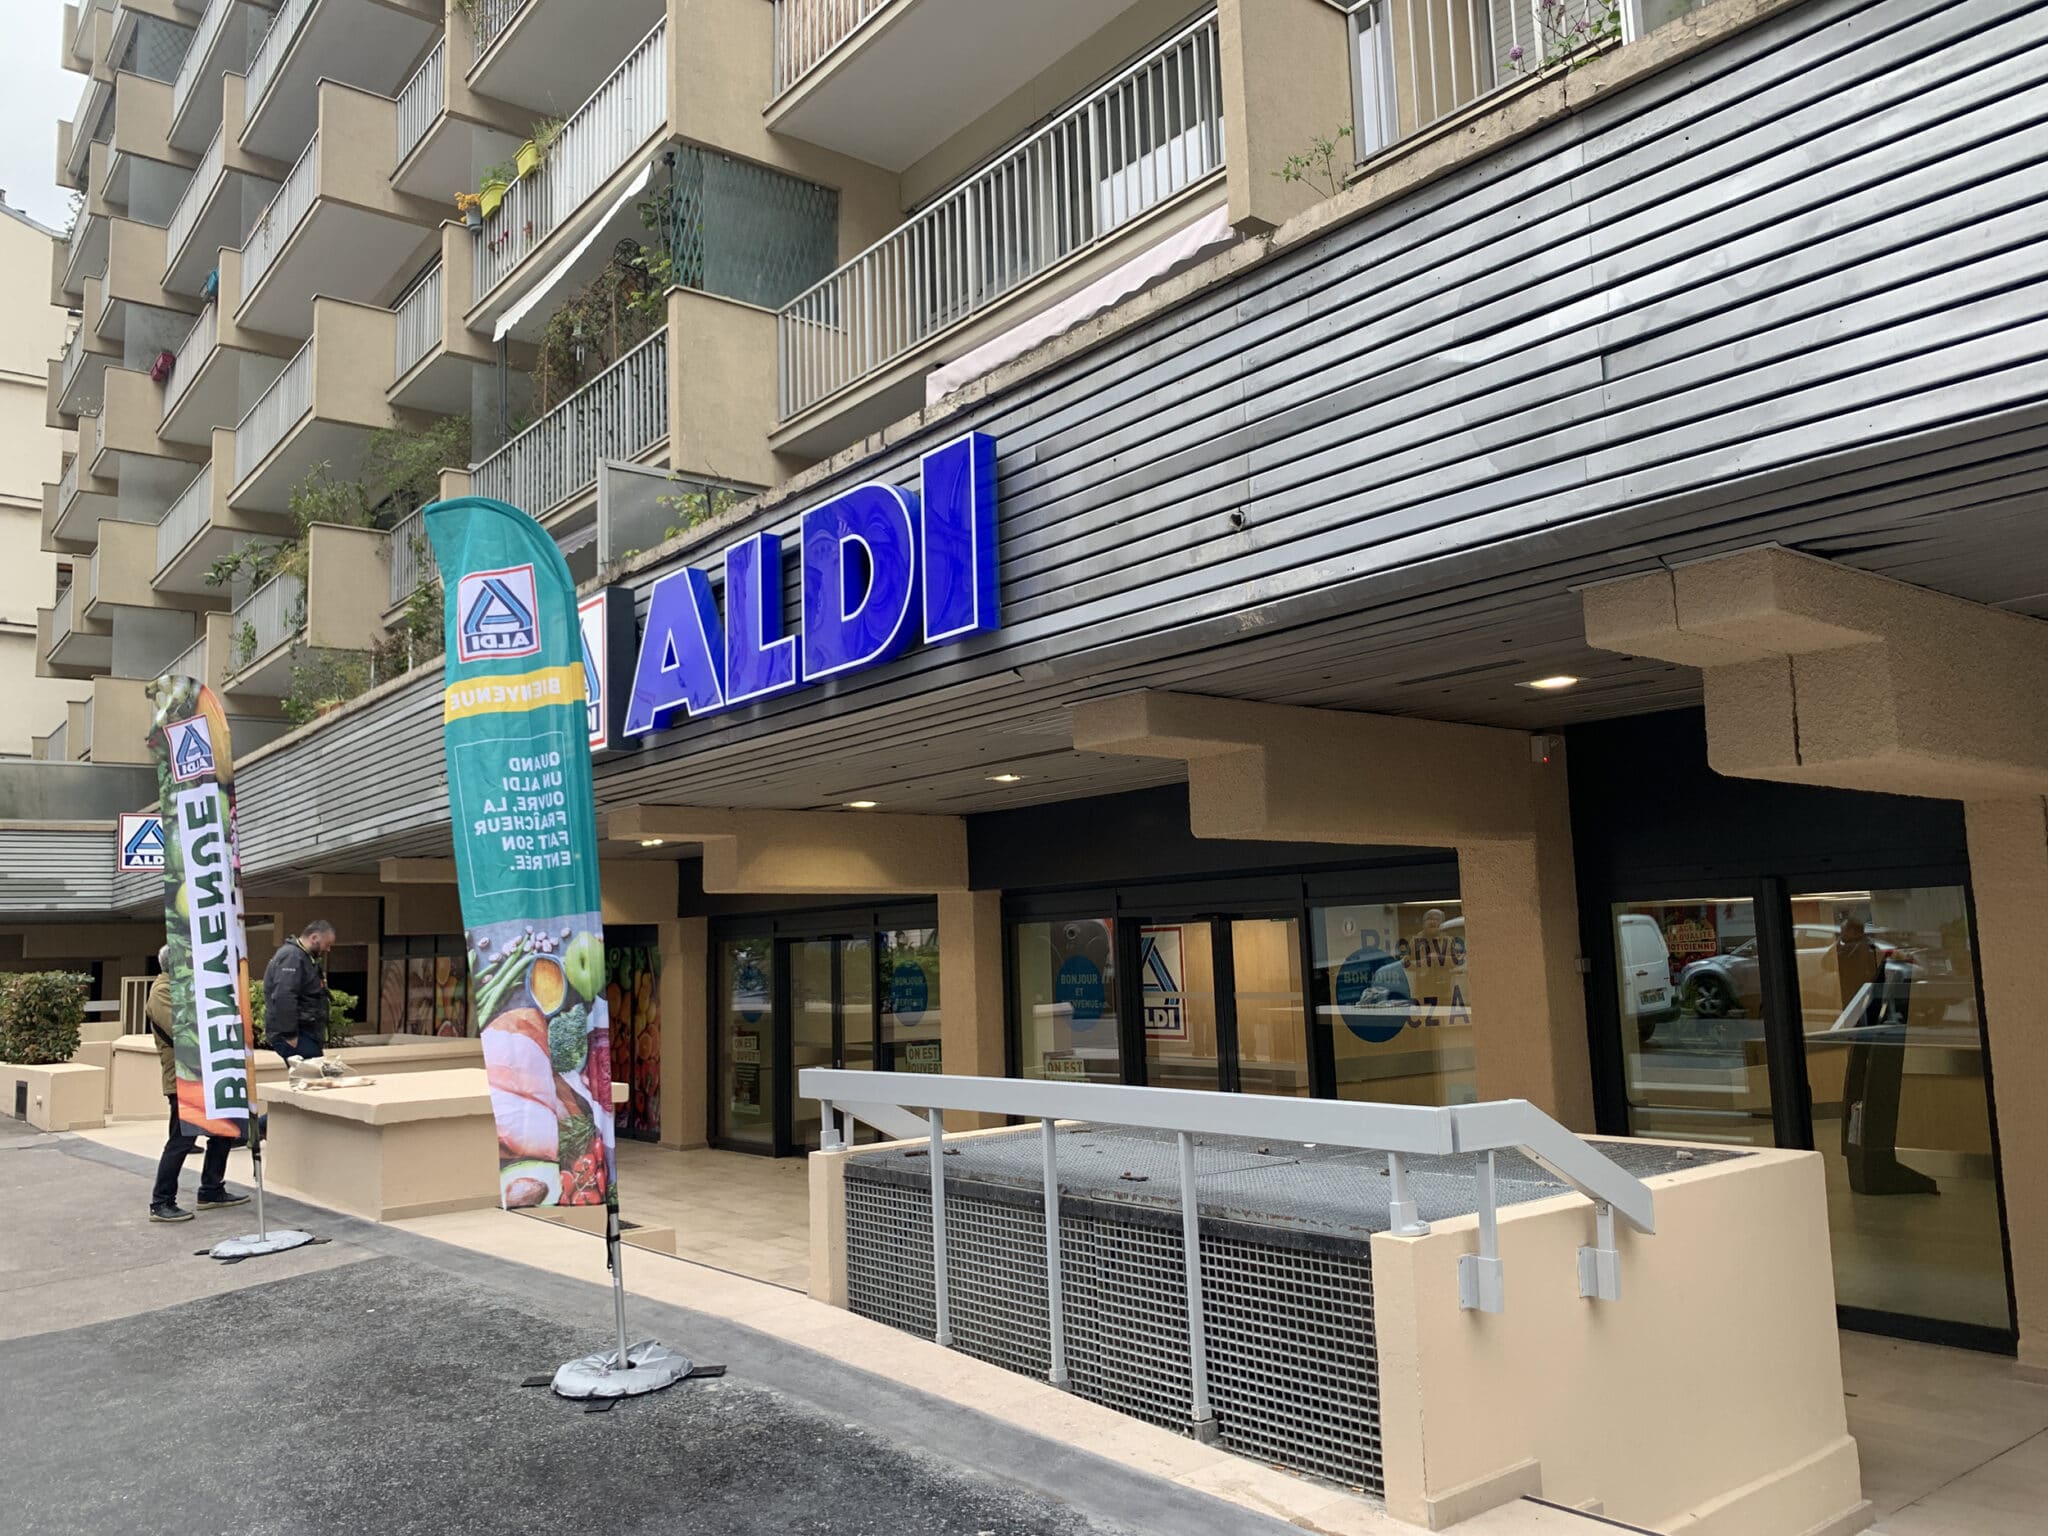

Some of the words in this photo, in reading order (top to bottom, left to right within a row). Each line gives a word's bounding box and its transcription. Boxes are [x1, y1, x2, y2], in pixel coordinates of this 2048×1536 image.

[624, 431, 1000, 737] ALDI
[129, 855, 165, 865] ALD
[1669, 942, 1715, 951] OTIDIENNE
[1060, 973, 1098, 985] BONJOUR
[1075, 987, 1084, 996] ET
[1061, 999, 1099, 1009] NVENUE
[1144, 1008, 1176, 1028] LDI
[1409, 997, 1440, 1028] ez
[909, 1048, 920, 1060] ON
[922, 1046, 938, 1059] EST
[1047, 1061, 1061, 1072] ON
[1063, 1060, 1083, 1072] EST
